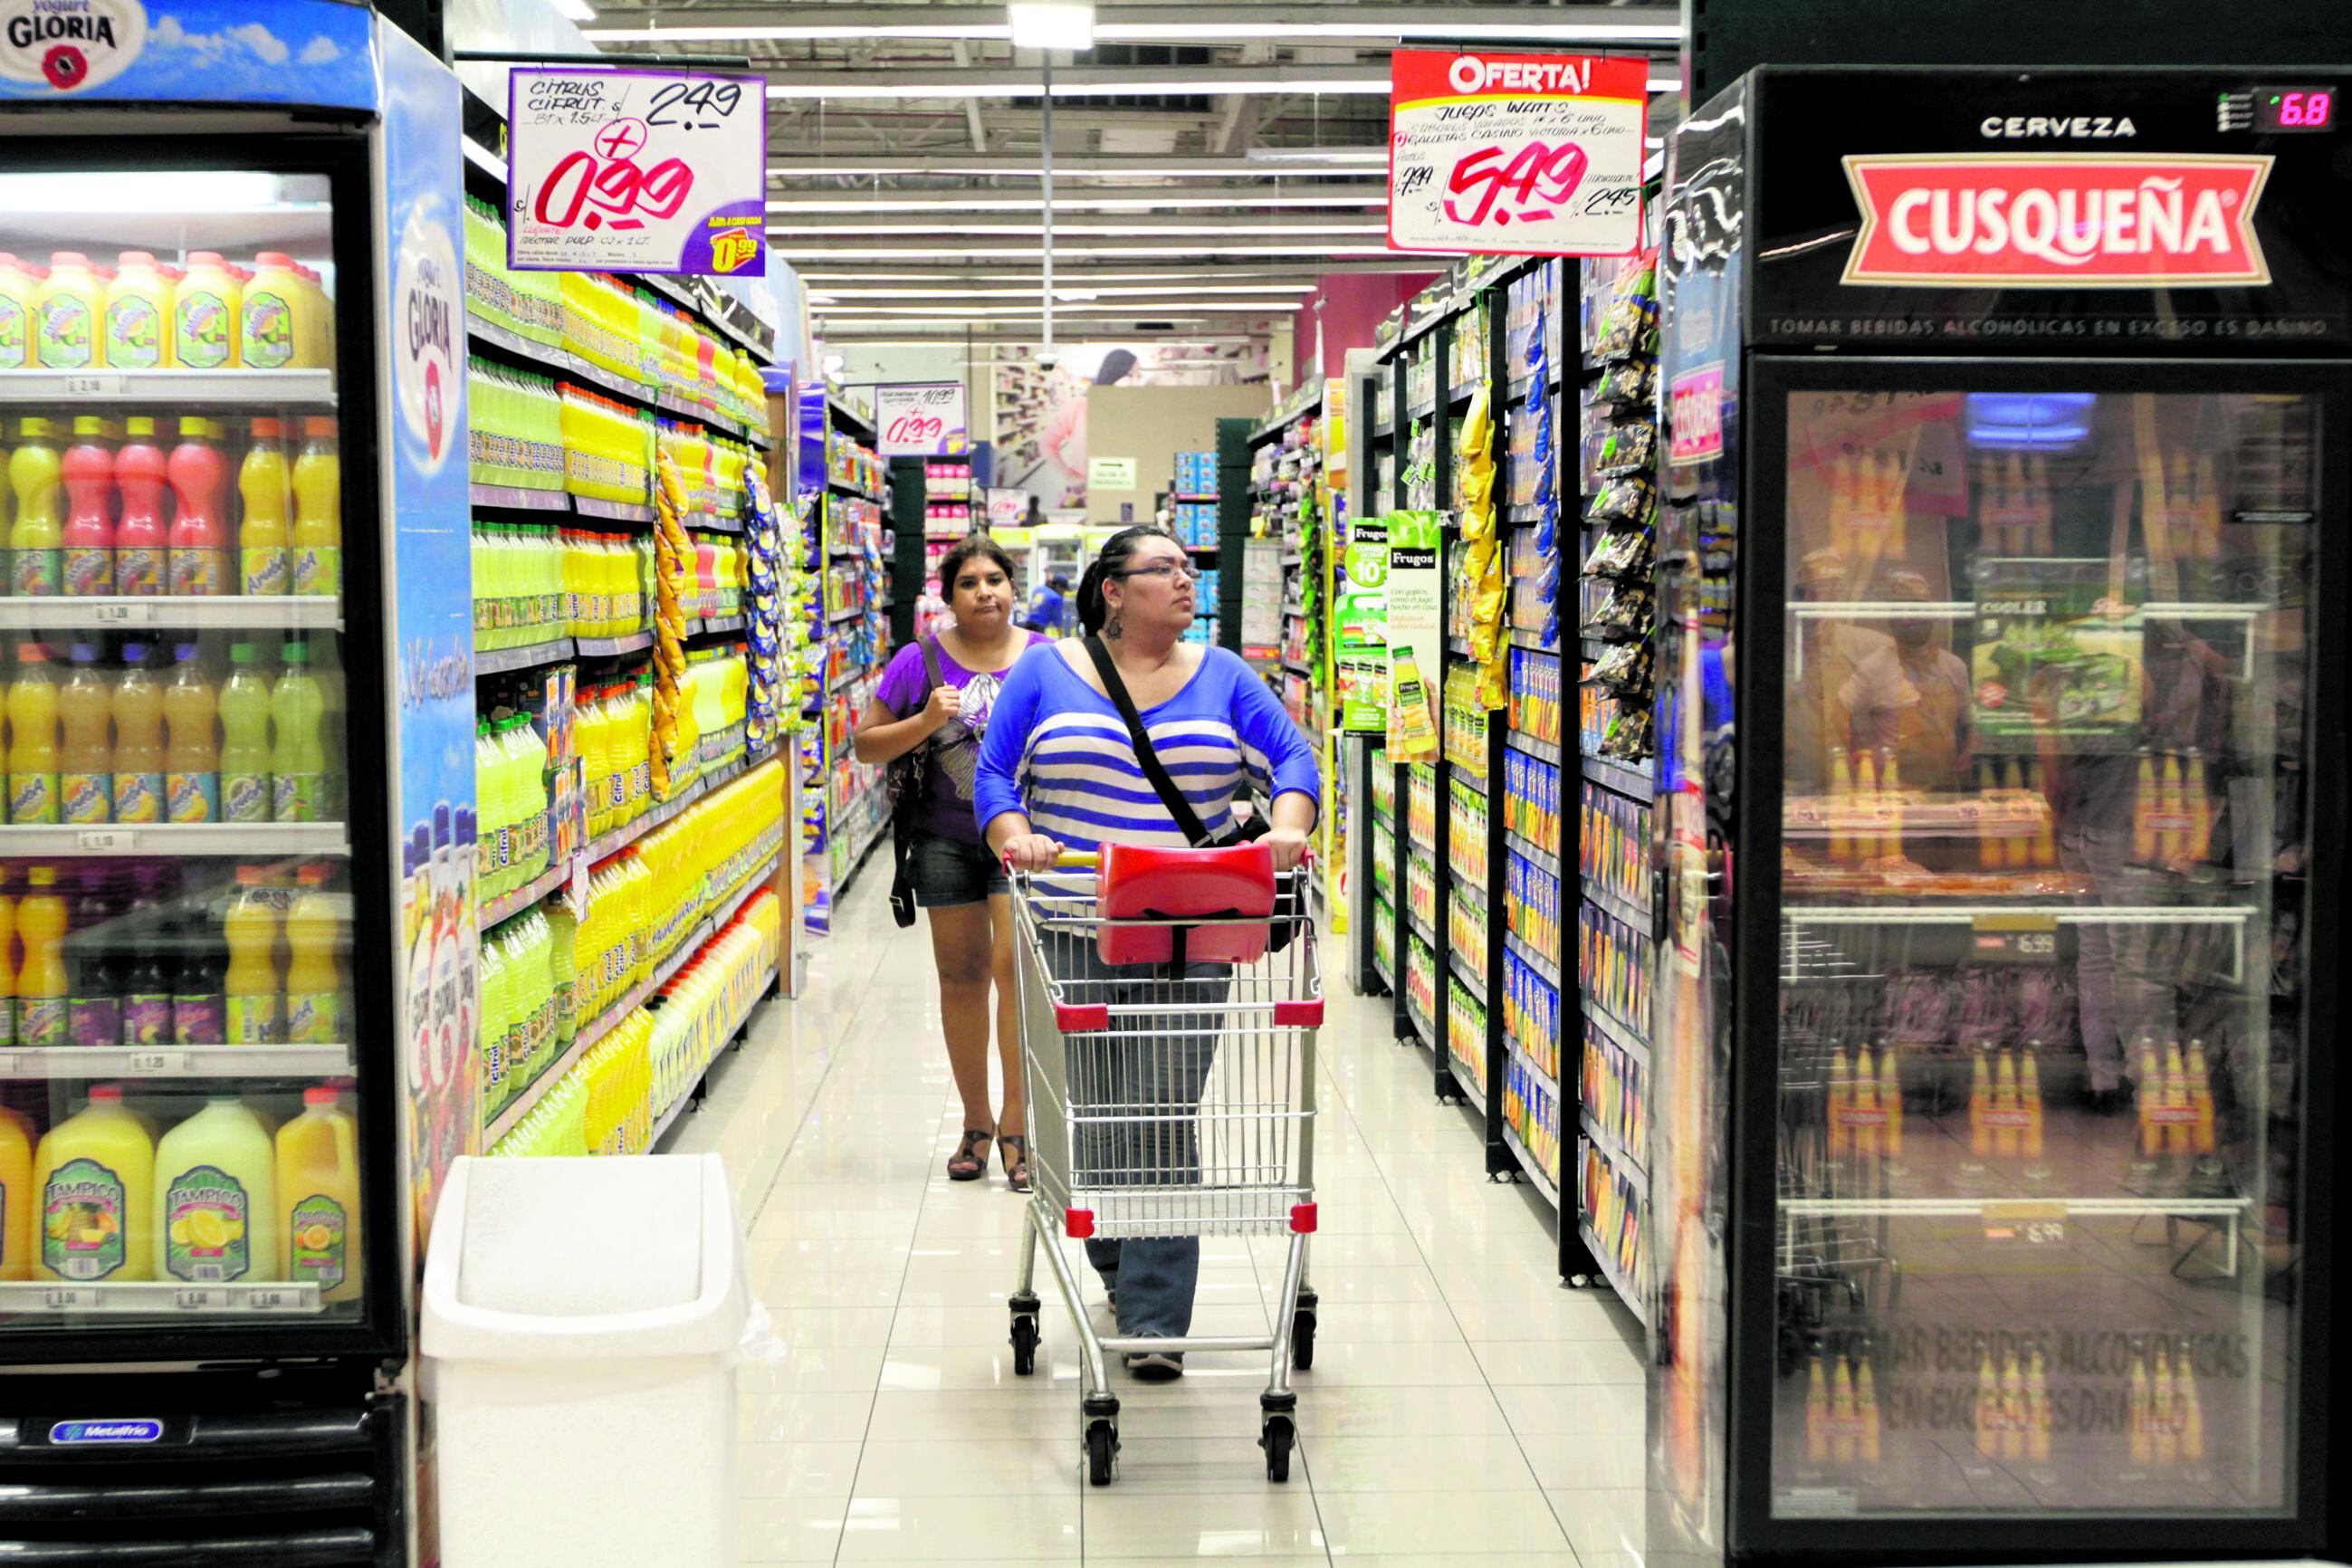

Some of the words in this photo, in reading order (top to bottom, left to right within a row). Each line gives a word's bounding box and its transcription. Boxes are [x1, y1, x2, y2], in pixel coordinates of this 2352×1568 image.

[7, 15, 117, 49] GLORIA
[645, 82, 742, 131] 2.49
[2280, 92, 2331, 127] 6.8
[1981, 117, 2137, 139] CERVEZA
[1443, 141, 1589, 226] 5.49
[1888, 176, 2232, 266] CUSQUEÑA
[408, 288, 452, 373] GLORIA
[1771, 319, 1841, 335] TOMAR
[1850, 319, 1935, 335] BEBIDAS
[2094, 319, 2120, 335] EN
[2214, 320, 2239, 335] ES
[1391, 551, 1434, 568] Frugos
[47, 1181, 120, 1202] TAMPICO
[168, 1188, 244, 1209] TAMPICO
[84, 1426, 149, 1437] Metalfrio
